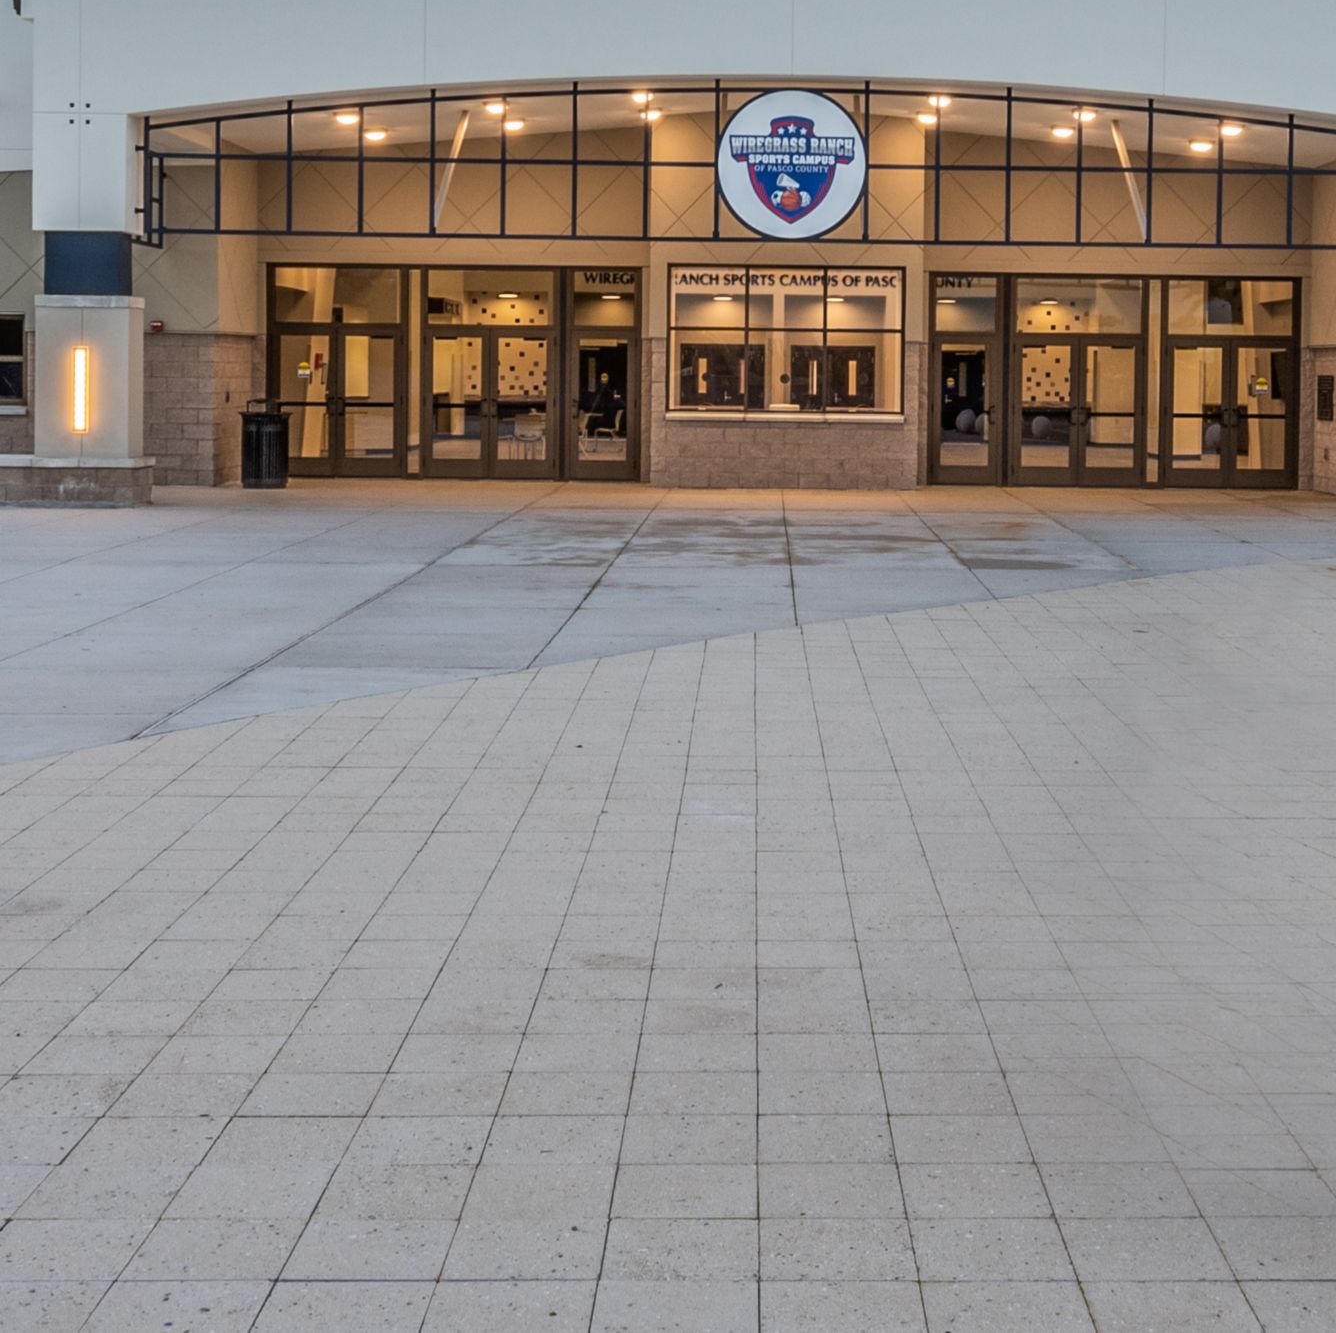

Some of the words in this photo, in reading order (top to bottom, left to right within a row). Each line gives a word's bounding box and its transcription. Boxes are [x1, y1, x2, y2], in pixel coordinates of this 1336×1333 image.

[732, 136, 807, 154] WIREGRASS
[810, 137, 853, 156] RANCH
[748, 154, 790, 164] SPORTS
[792, 154, 835, 165] CAMPUS
[768, 165, 793, 173] PASCO
[795, 165, 829, 173] COUNTY
[675, 273, 719, 286] ANCH
[723, 273, 775, 286] SPORTS
[842, 274, 861, 287] OF
